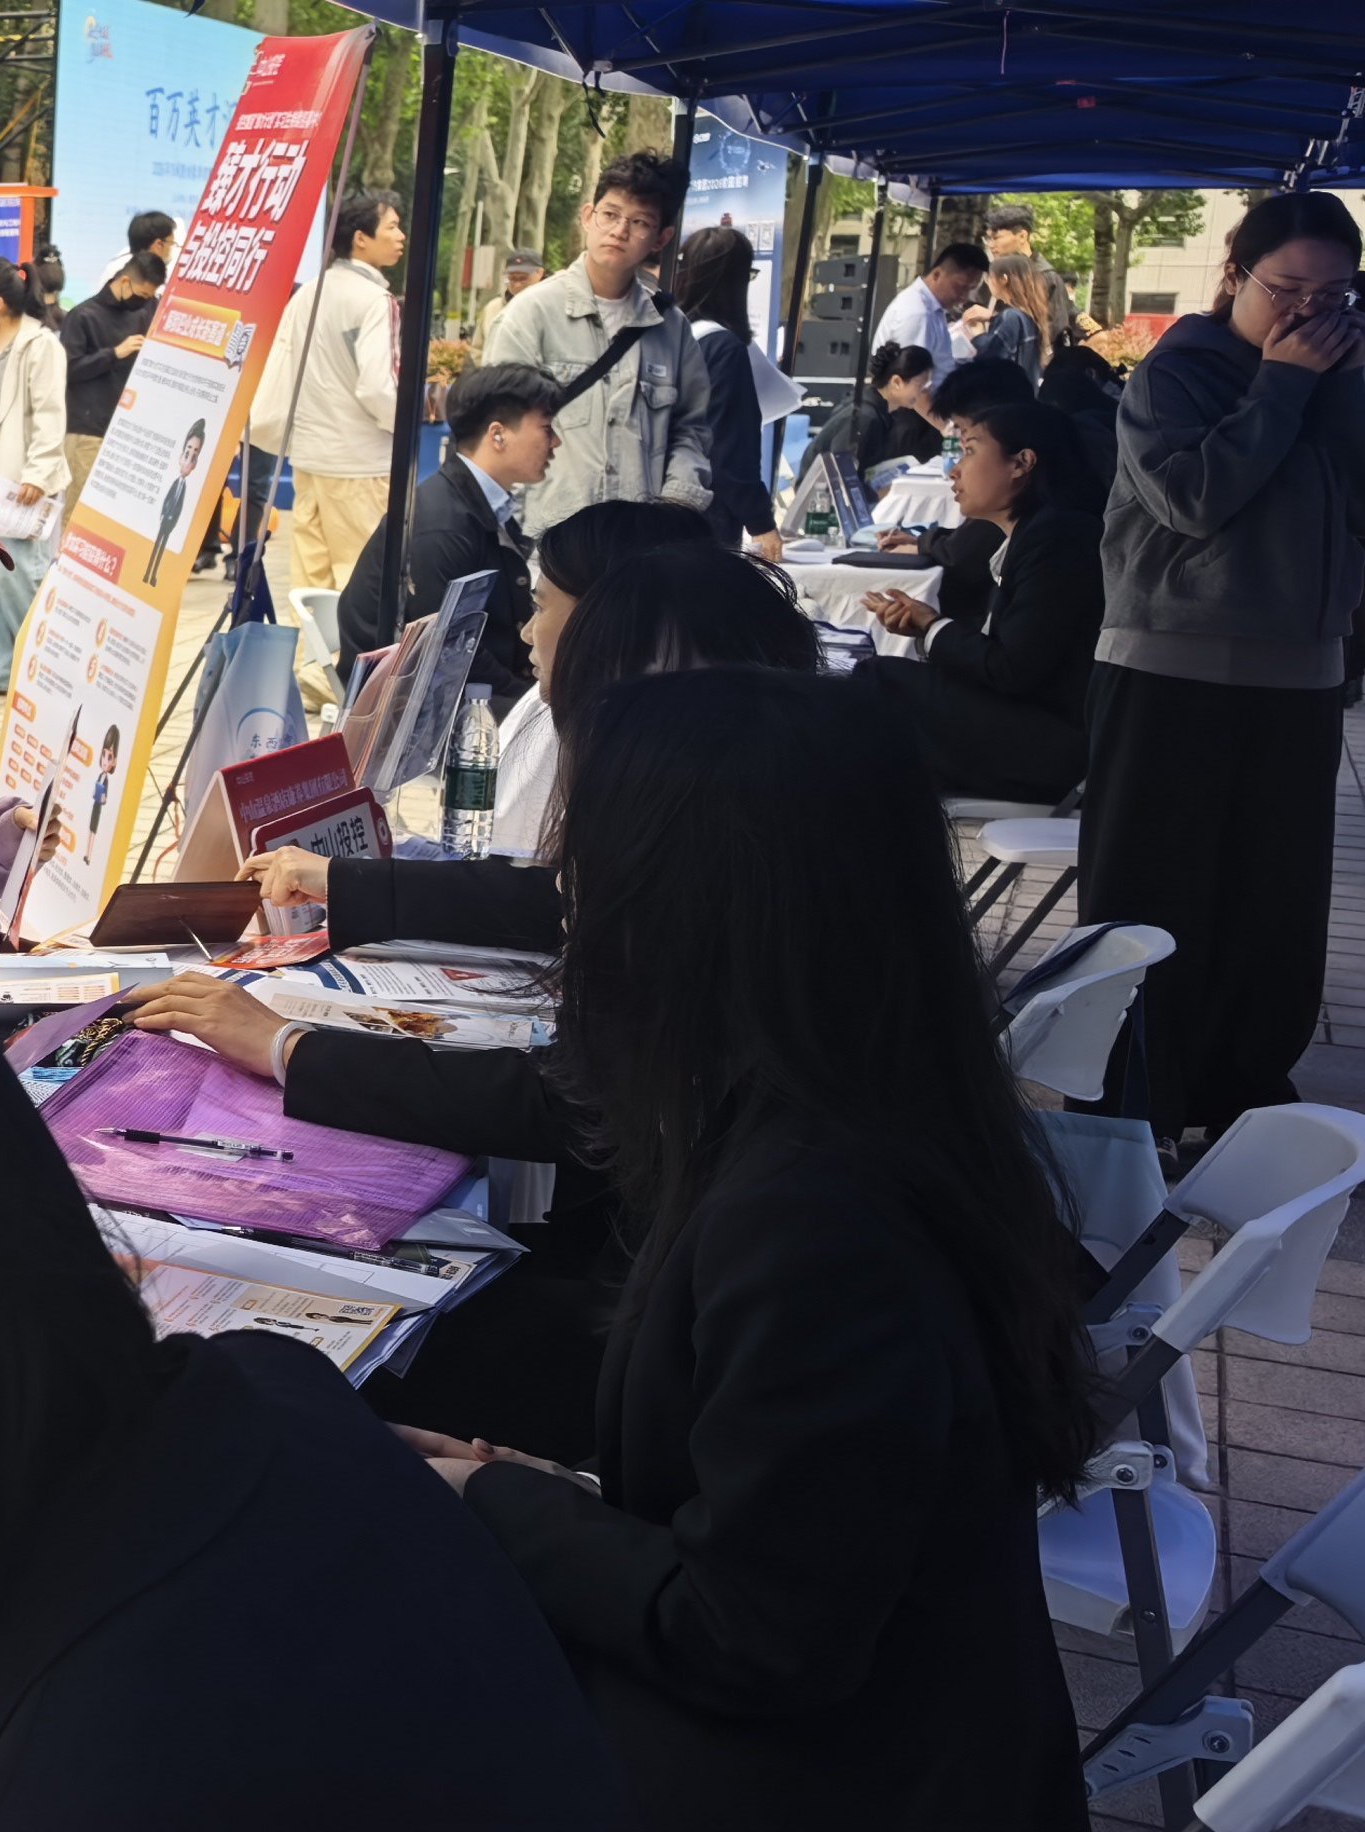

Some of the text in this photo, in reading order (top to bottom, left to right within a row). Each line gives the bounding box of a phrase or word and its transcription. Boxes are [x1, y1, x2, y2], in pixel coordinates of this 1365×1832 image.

[177, 221, 275, 293] 与投控同行
[311, 816, 368, 858] 中山投控
